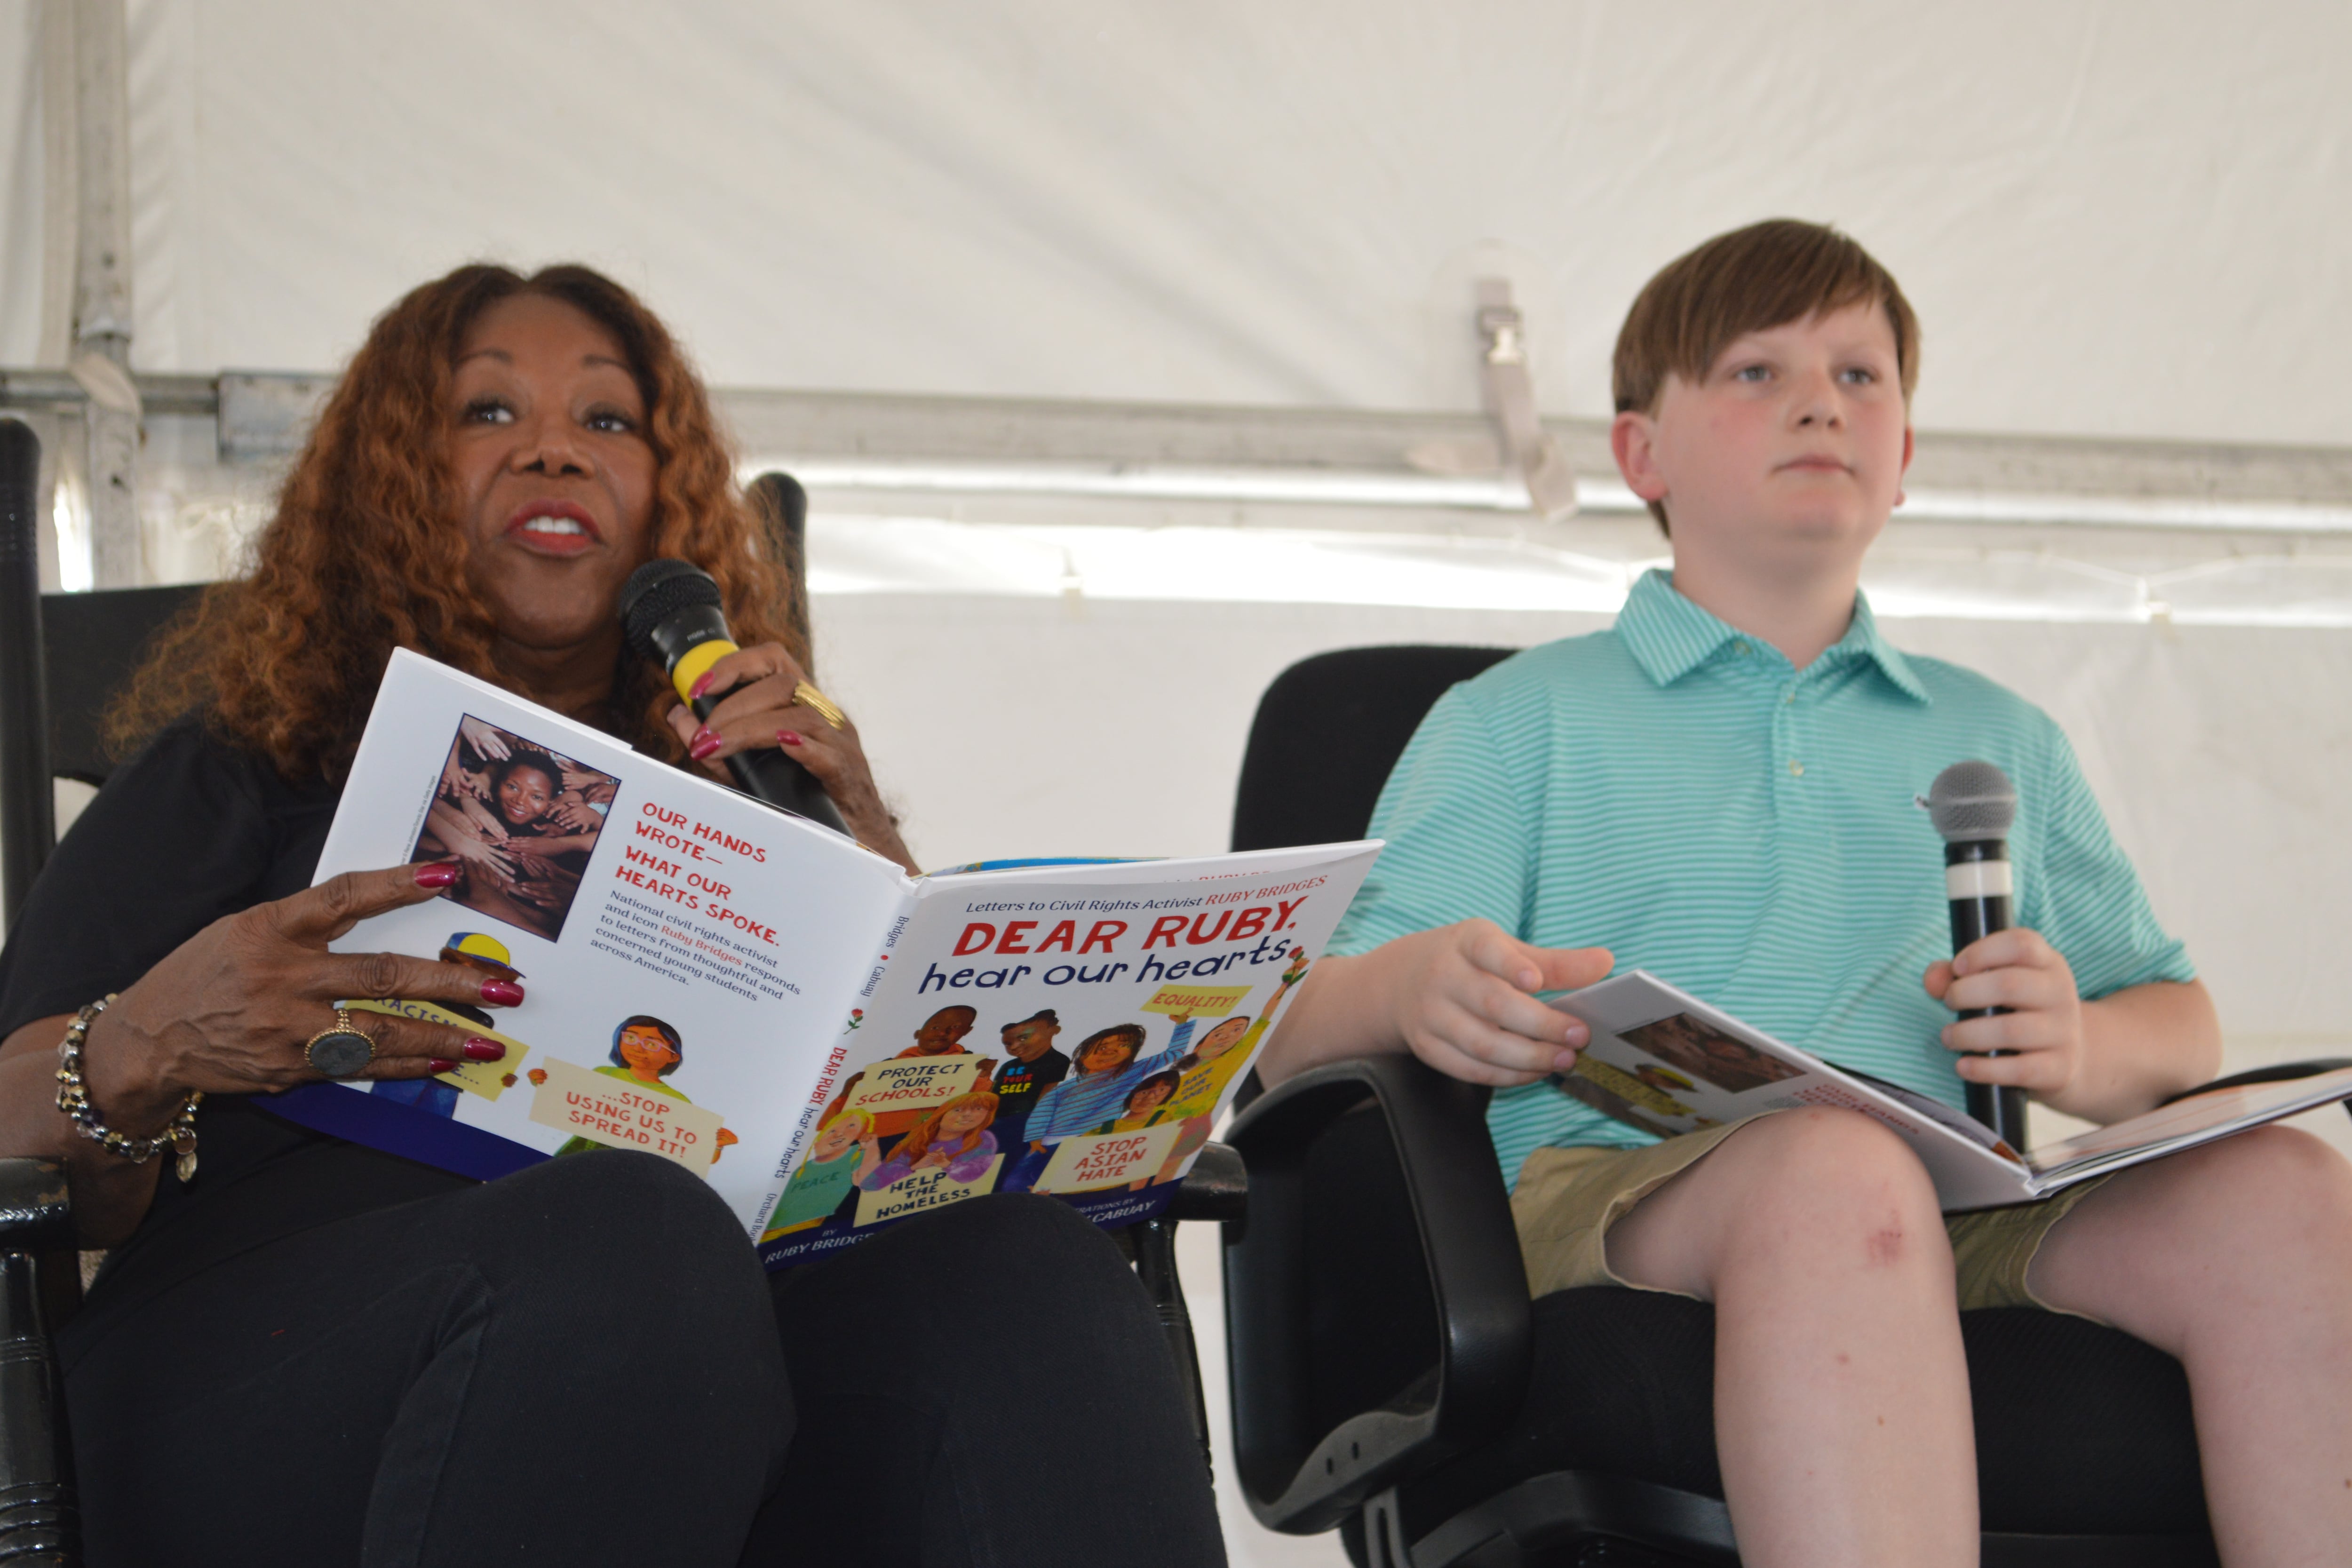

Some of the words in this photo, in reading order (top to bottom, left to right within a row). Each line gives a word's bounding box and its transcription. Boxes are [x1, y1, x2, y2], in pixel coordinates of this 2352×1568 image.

[643, 803, 687, 830] OUR
[692, 822, 765, 862] HANDS
[625, 845, 682, 878] WHAT
[687, 873, 731, 900] OUR
[615, 866, 698, 909] HEARTS
[706, 904, 779, 947] SPOKE.
[966, 902, 1024, 913] Letters
[1030, 902, 1045, 911] to
[1049, 900, 1086, 911] Civil
[1088, 899, 1140, 913] Rights
[1142, 897, 1204, 910] Activist
[1205, 890, 1255, 906] RUBY
[1255, 875, 1328, 899] BRIDGES
[611, 891, 664, 918] National
[666, 915, 692, 930] civil
[694, 926, 731, 947] rights
[732, 943, 778, 968] activist
[885, 915, 909, 948] Bridges
[951, 920, 1128, 957] DEAR
[1140, 895, 1310, 950] RUBY,
[590, 939, 633, 961] across
[634, 957, 689, 985] America.
[601, 915, 613, 925] to
[616, 921, 657, 943] letters
[659, 939, 690, 957] from
[693, 953, 758, 987] thoughtful
[759, 984, 783, 1000] and
[605, 904, 629, 918] and
[632, 913, 658, 930] icon
[661, 925, 692, 946] Ruby
[695, 939, 742, 965] Bridges
[745, 963, 801, 995] responds
[596, 928, 662, 959] concerned
[663, 956, 702, 978] young
[705, 973, 758, 1001] students
[917, 962, 1032, 995] hear
[1043, 962, 1128, 986] our
[860, 966, 885, 997] Cabuay
[1152, 994, 1239, 1008] EQUALITY!
[822, 1047, 847, 1075] DEAR
[877, 1064, 964, 1080] PROTECT
[1007, 1066, 1025, 1076] BE
[809, 1077, 834, 1106] RUBY,
[855, 1086, 956, 1106] SCHOOLS!
[892, 1077, 933, 1089] OUR
[1000, 1082, 1032, 1094] SELF
[566, 1091, 631, 1122] USING
[639, 1114, 665, 1133] US
[675, 1126, 697, 1144] TO
[602, 1092, 670, 1115] ...STOP
[798, 1107, 818, 1129] hear
[568, 1110, 650, 1144] SPREAD
[658, 1138, 687, 1158] IT!
[790, 1130, 804, 1147] our
[1090, 1137, 1147, 1155] STOP
[774, 1147, 800, 1178] hearts
[1073, 1148, 1147, 1170] ASIAN
[790, 1171, 840, 1194] PEACE
[890, 1171, 947, 1194] HELP
[1076, 1165, 1127, 1182] HATE
[876, 1188, 970, 1219] HOMELESS
[905, 1184, 938, 1199] THE
[1122, 1197, 1136, 1206] BY
[755, 1193, 778, 1225] Orchard
[1092, 1200, 1156, 1223] CABUAY
[749, 1225, 762, 1241] Boo
[765, 1243, 810, 1264] RUBY
